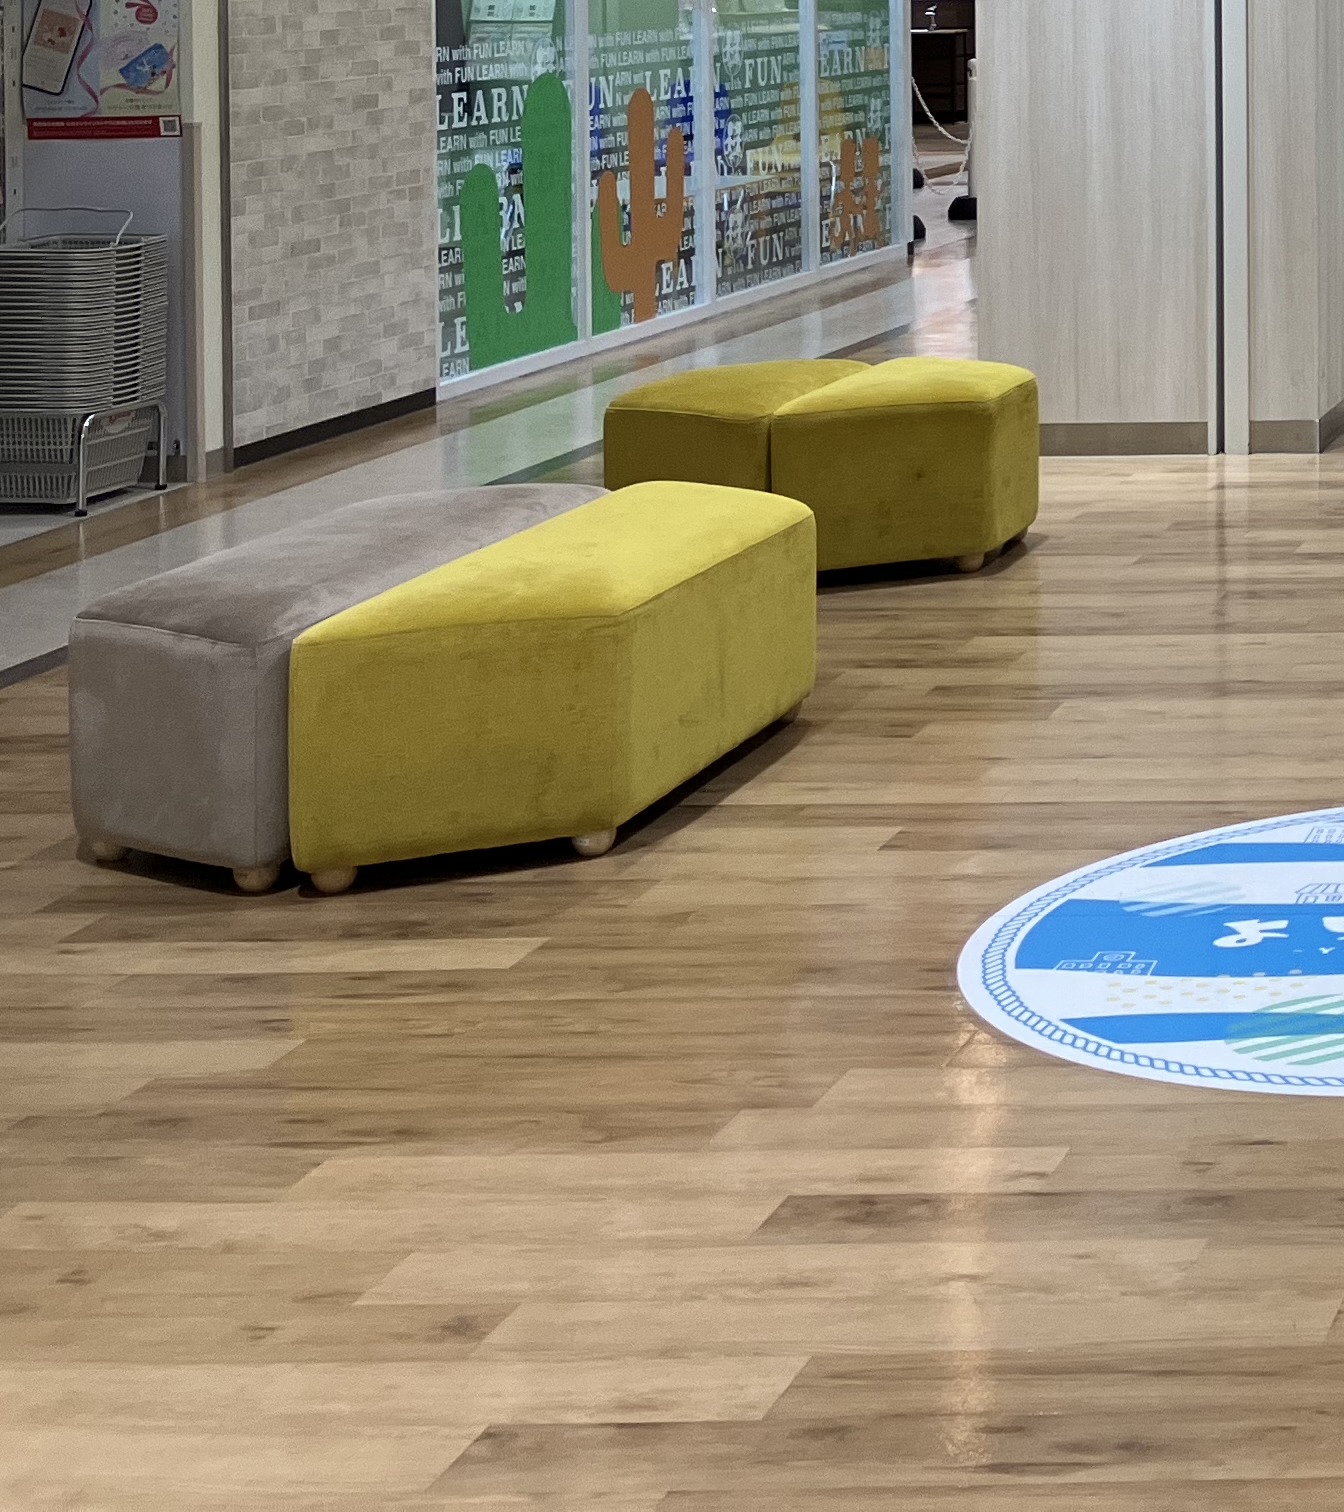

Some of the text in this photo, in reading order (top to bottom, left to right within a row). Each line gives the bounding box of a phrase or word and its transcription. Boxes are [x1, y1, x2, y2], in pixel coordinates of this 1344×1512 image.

[455, 65, 475, 84] FUN
[743, 56, 783, 89] FUN
[747, 232, 785, 270] FUN
